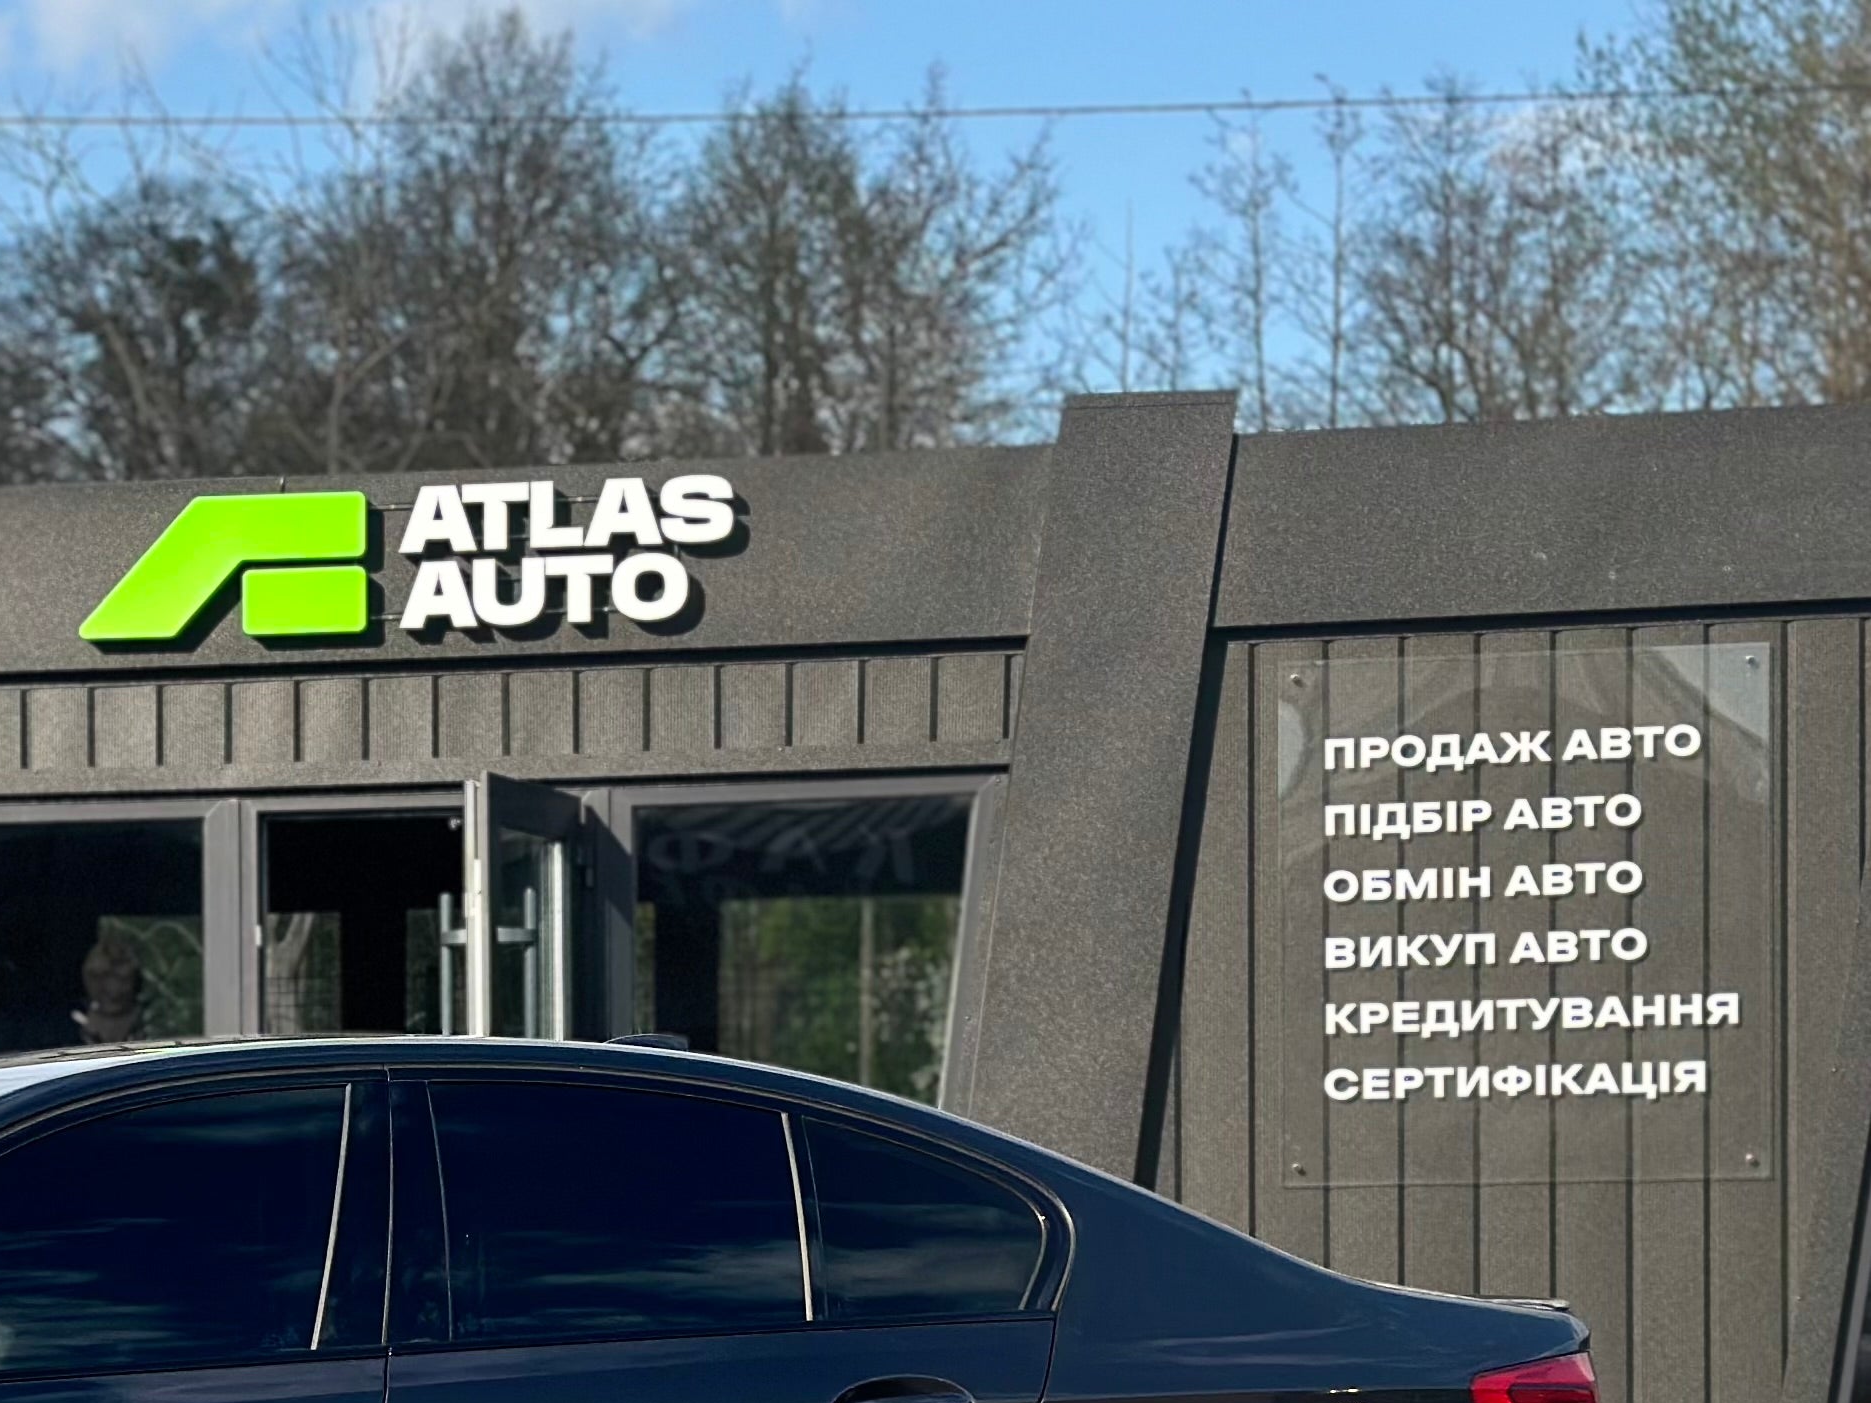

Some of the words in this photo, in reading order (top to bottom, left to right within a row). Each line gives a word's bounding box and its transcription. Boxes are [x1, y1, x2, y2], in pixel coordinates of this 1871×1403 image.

[398, 474, 734, 555] ATLAS
[398, 552, 689, 630] AUTO
[1323, 729, 1552, 773] ПРОДАЖ
[1561, 723, 1702, 761] АВТО
[1323, 798, 1493, 841] ПІДБІР
[1503, 793, 1643, 831] АВТО
[1323, 866, 1492, 902] ОБМІН
[1503, 860, 1644, 898] АВТО
[1324, 931, 1496, 969] ВИКУП
[1509, 926, 1648, 964] АВТО
[1324, 991, 1740, 1039] КРЕДИТУВАННЯ
[1323, 1059, 1707, 1101] СЕРТИФІКАЦІЯ
